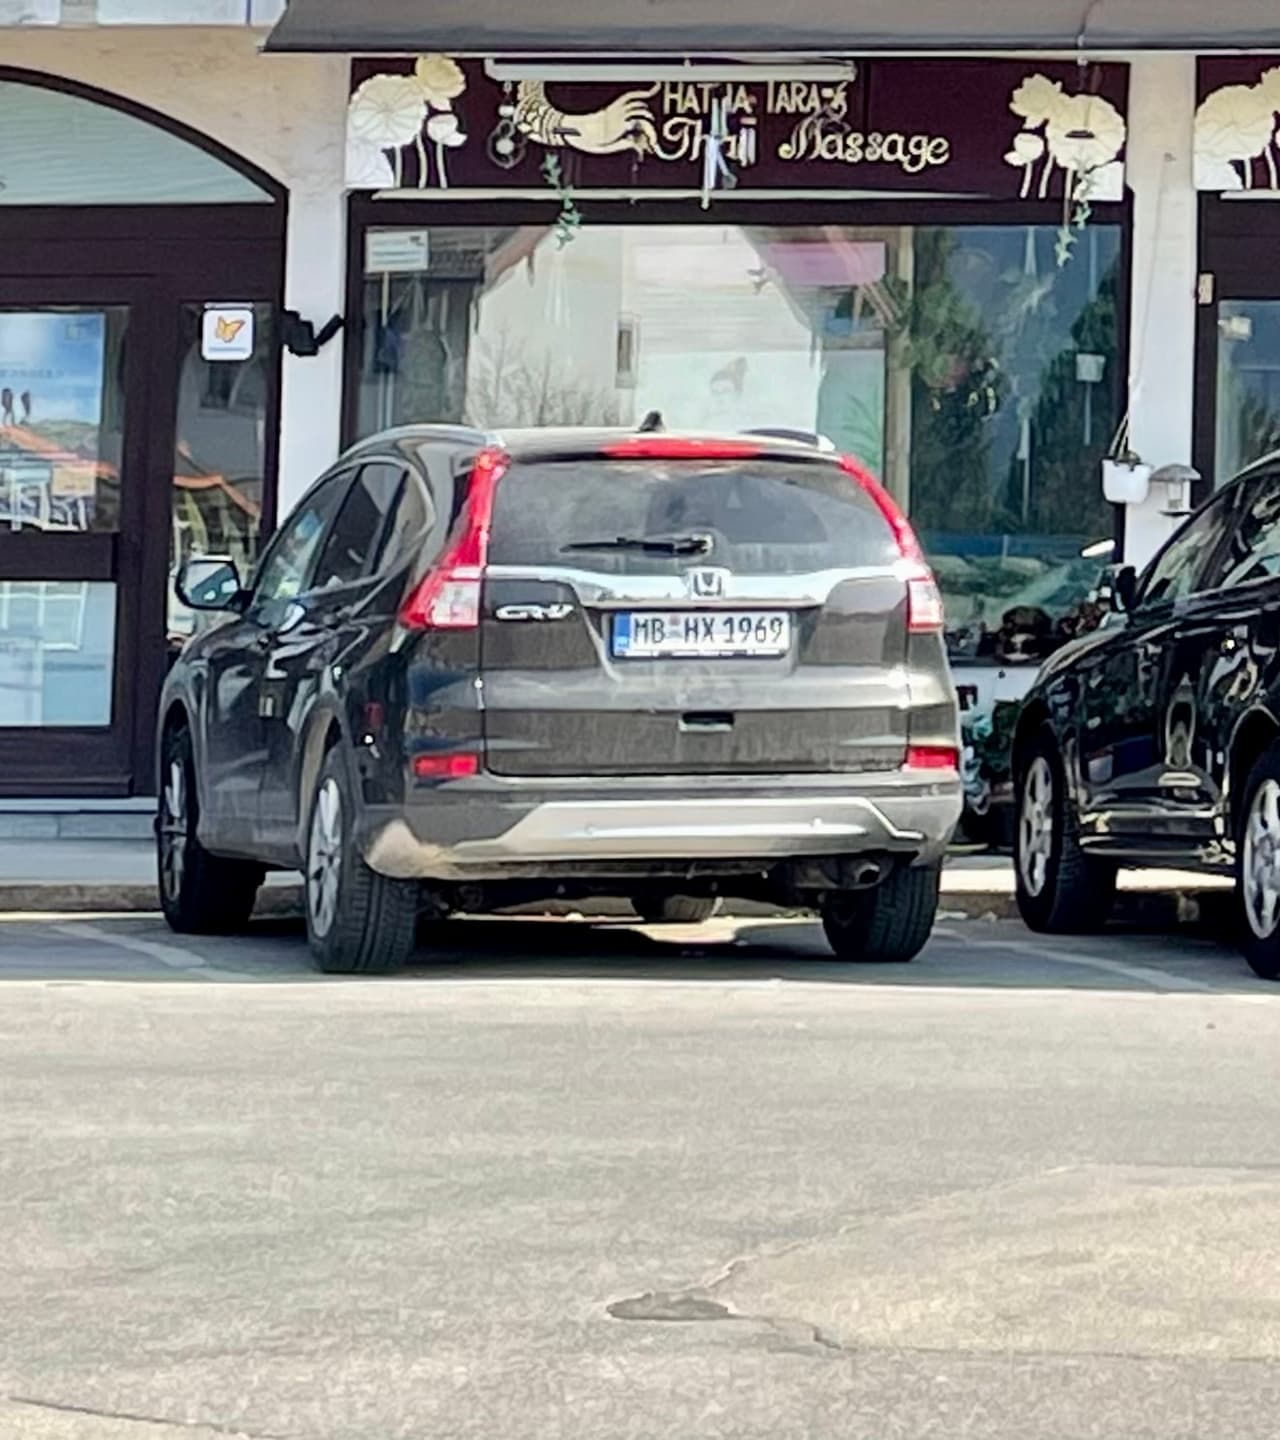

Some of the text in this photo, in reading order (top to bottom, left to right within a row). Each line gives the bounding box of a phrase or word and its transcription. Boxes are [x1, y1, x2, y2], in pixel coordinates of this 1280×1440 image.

[656, 110, 950, 172] Tha Massage
[632, 616, 785, 644] MB HX 1969
